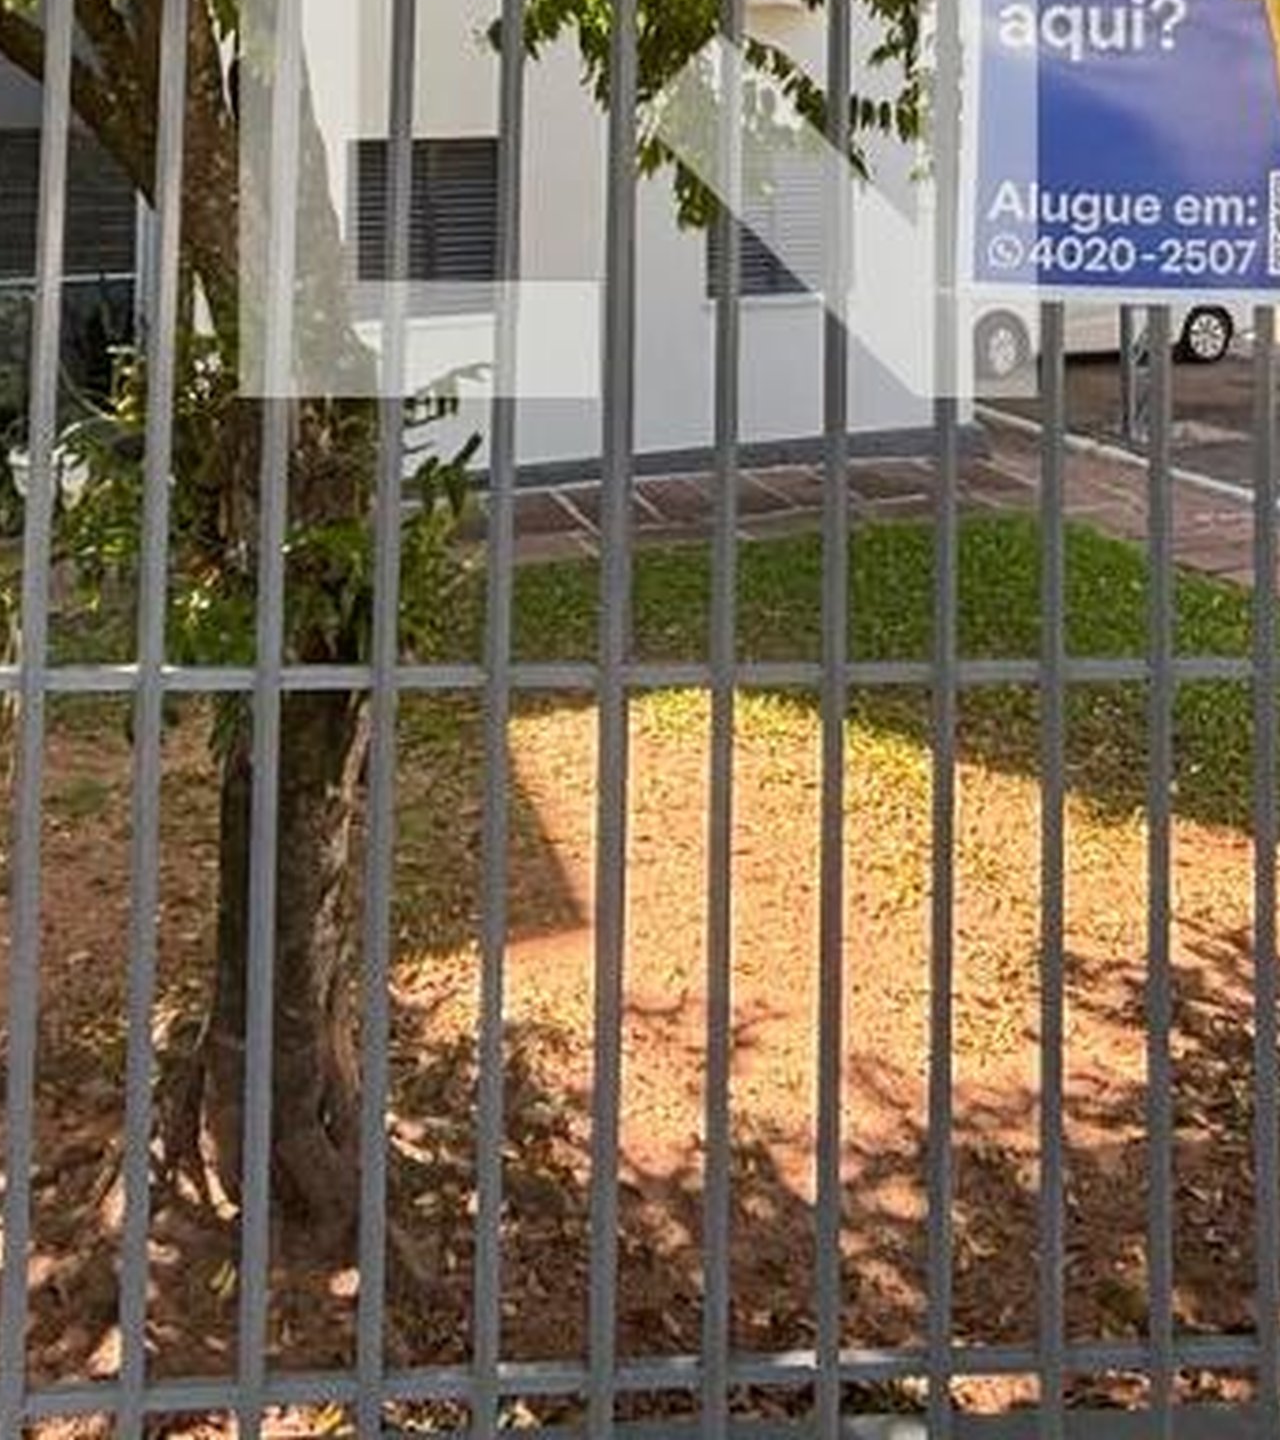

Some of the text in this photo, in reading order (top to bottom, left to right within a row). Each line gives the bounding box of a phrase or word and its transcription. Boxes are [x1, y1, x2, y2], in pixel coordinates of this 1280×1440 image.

[987, 179, 1258, 234] Alugue em:
[1028, 235, 1258, 276] 4020-2507
